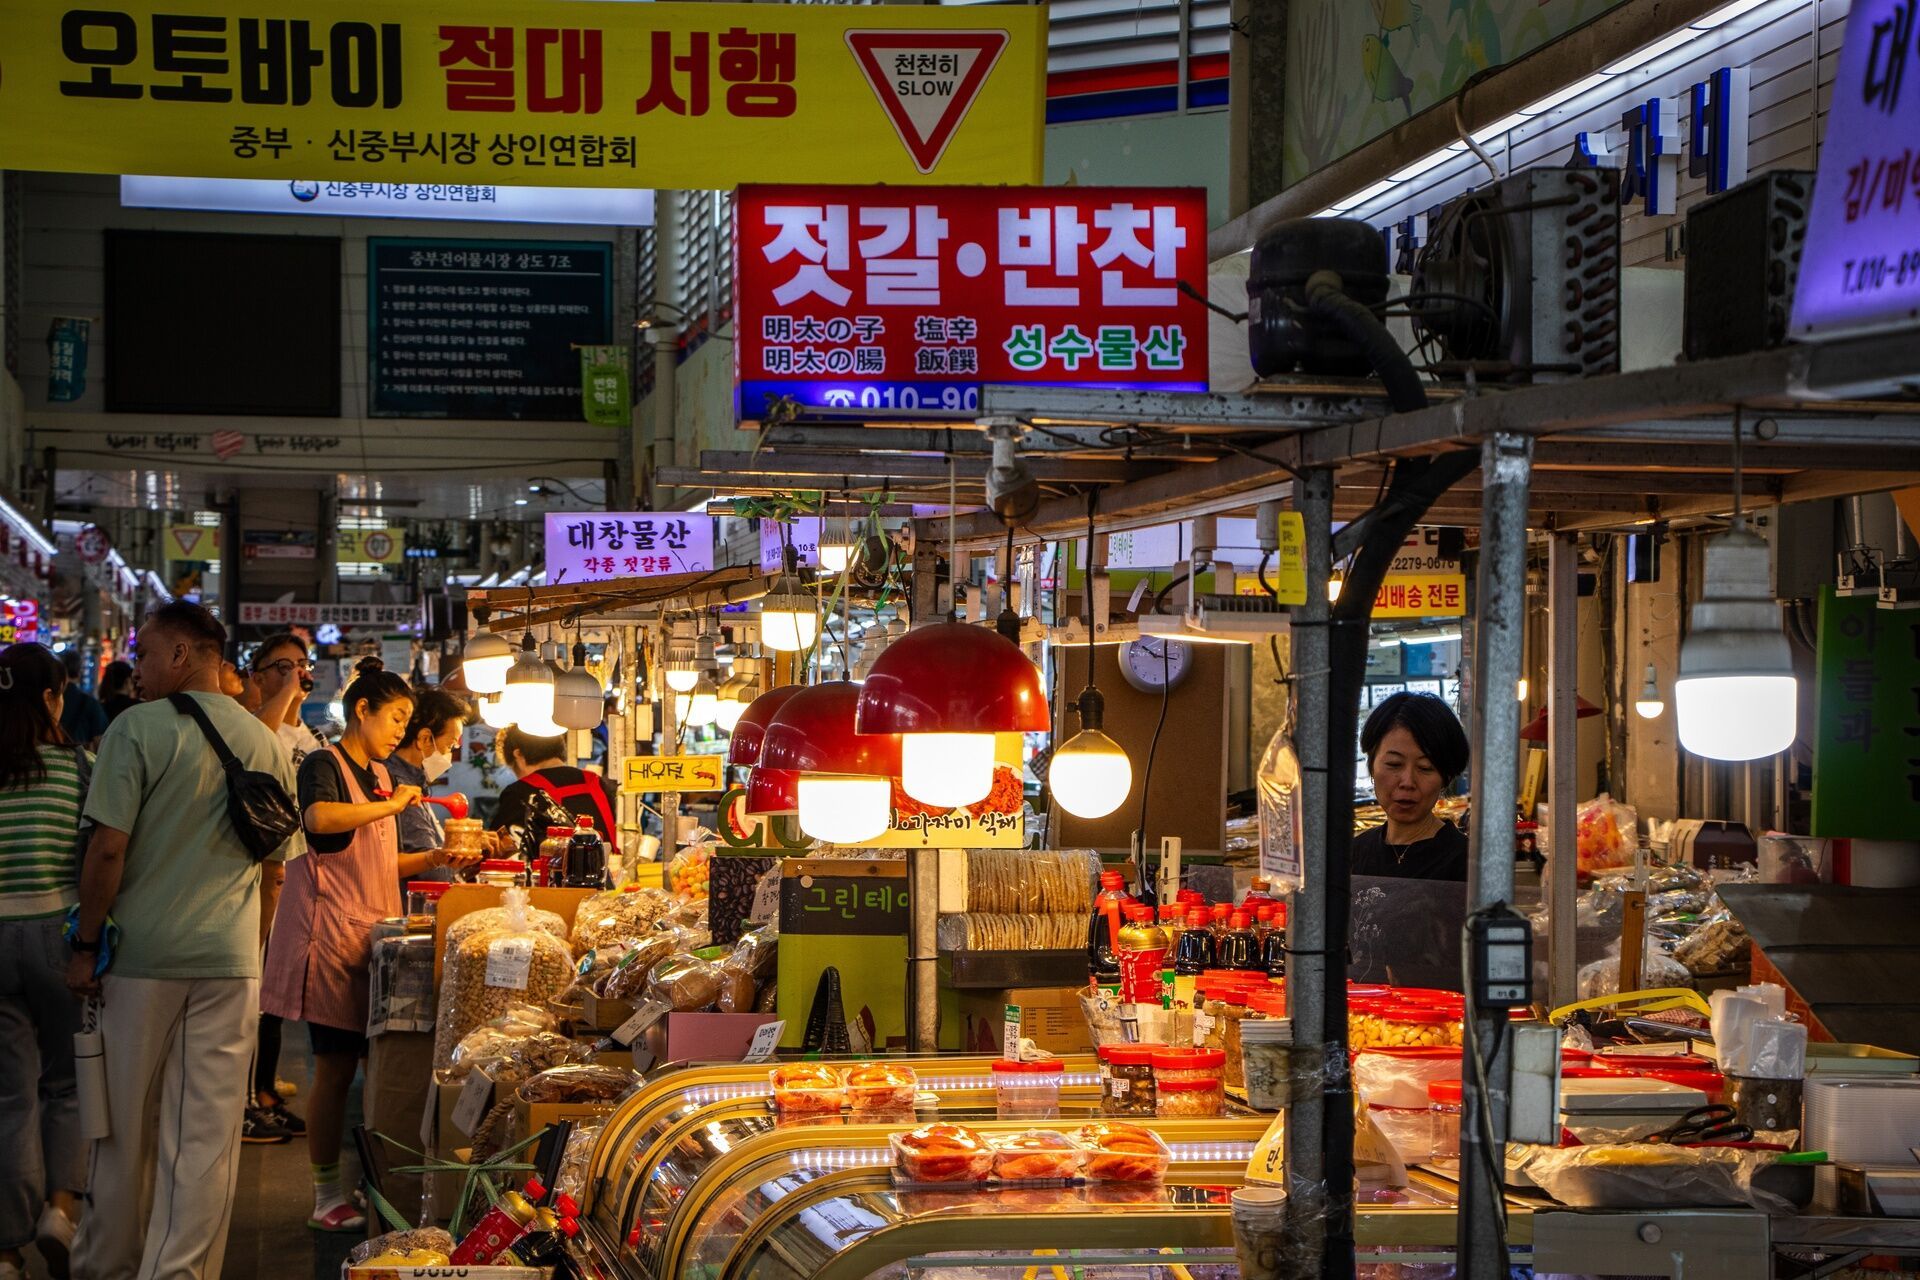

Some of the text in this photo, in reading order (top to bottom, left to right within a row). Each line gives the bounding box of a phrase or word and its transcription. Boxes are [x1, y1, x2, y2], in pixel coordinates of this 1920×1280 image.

[59, 10, 797, 118] 오토바이 절대 서행
[894, 54, 960, 77] 천천히
[1863, 0, 1920, 116] 대
[897, 81, 954, 97] SLOW
[229, 127, 637, 168] 중부 신중부시장 상인연합회
[414, 183, 497, 202] 상인연합회
[409, 251, 511, 269] 중부건어물시장
[761, 203, 1187, 307] 젓갈·반찬
[763, 315, 977, 343] 明太の子 塩辛
[763, 346, 885, 374] 明太の腸
[1003, 325, 1184, 370] 성수물산
[567, 519, 690, 551] 대창물산
[583, 556, 673, 573] 각종 젓갈류
[1428, 584, 1460, 609] 전문
[979, 813, 1017, 837] 식해
